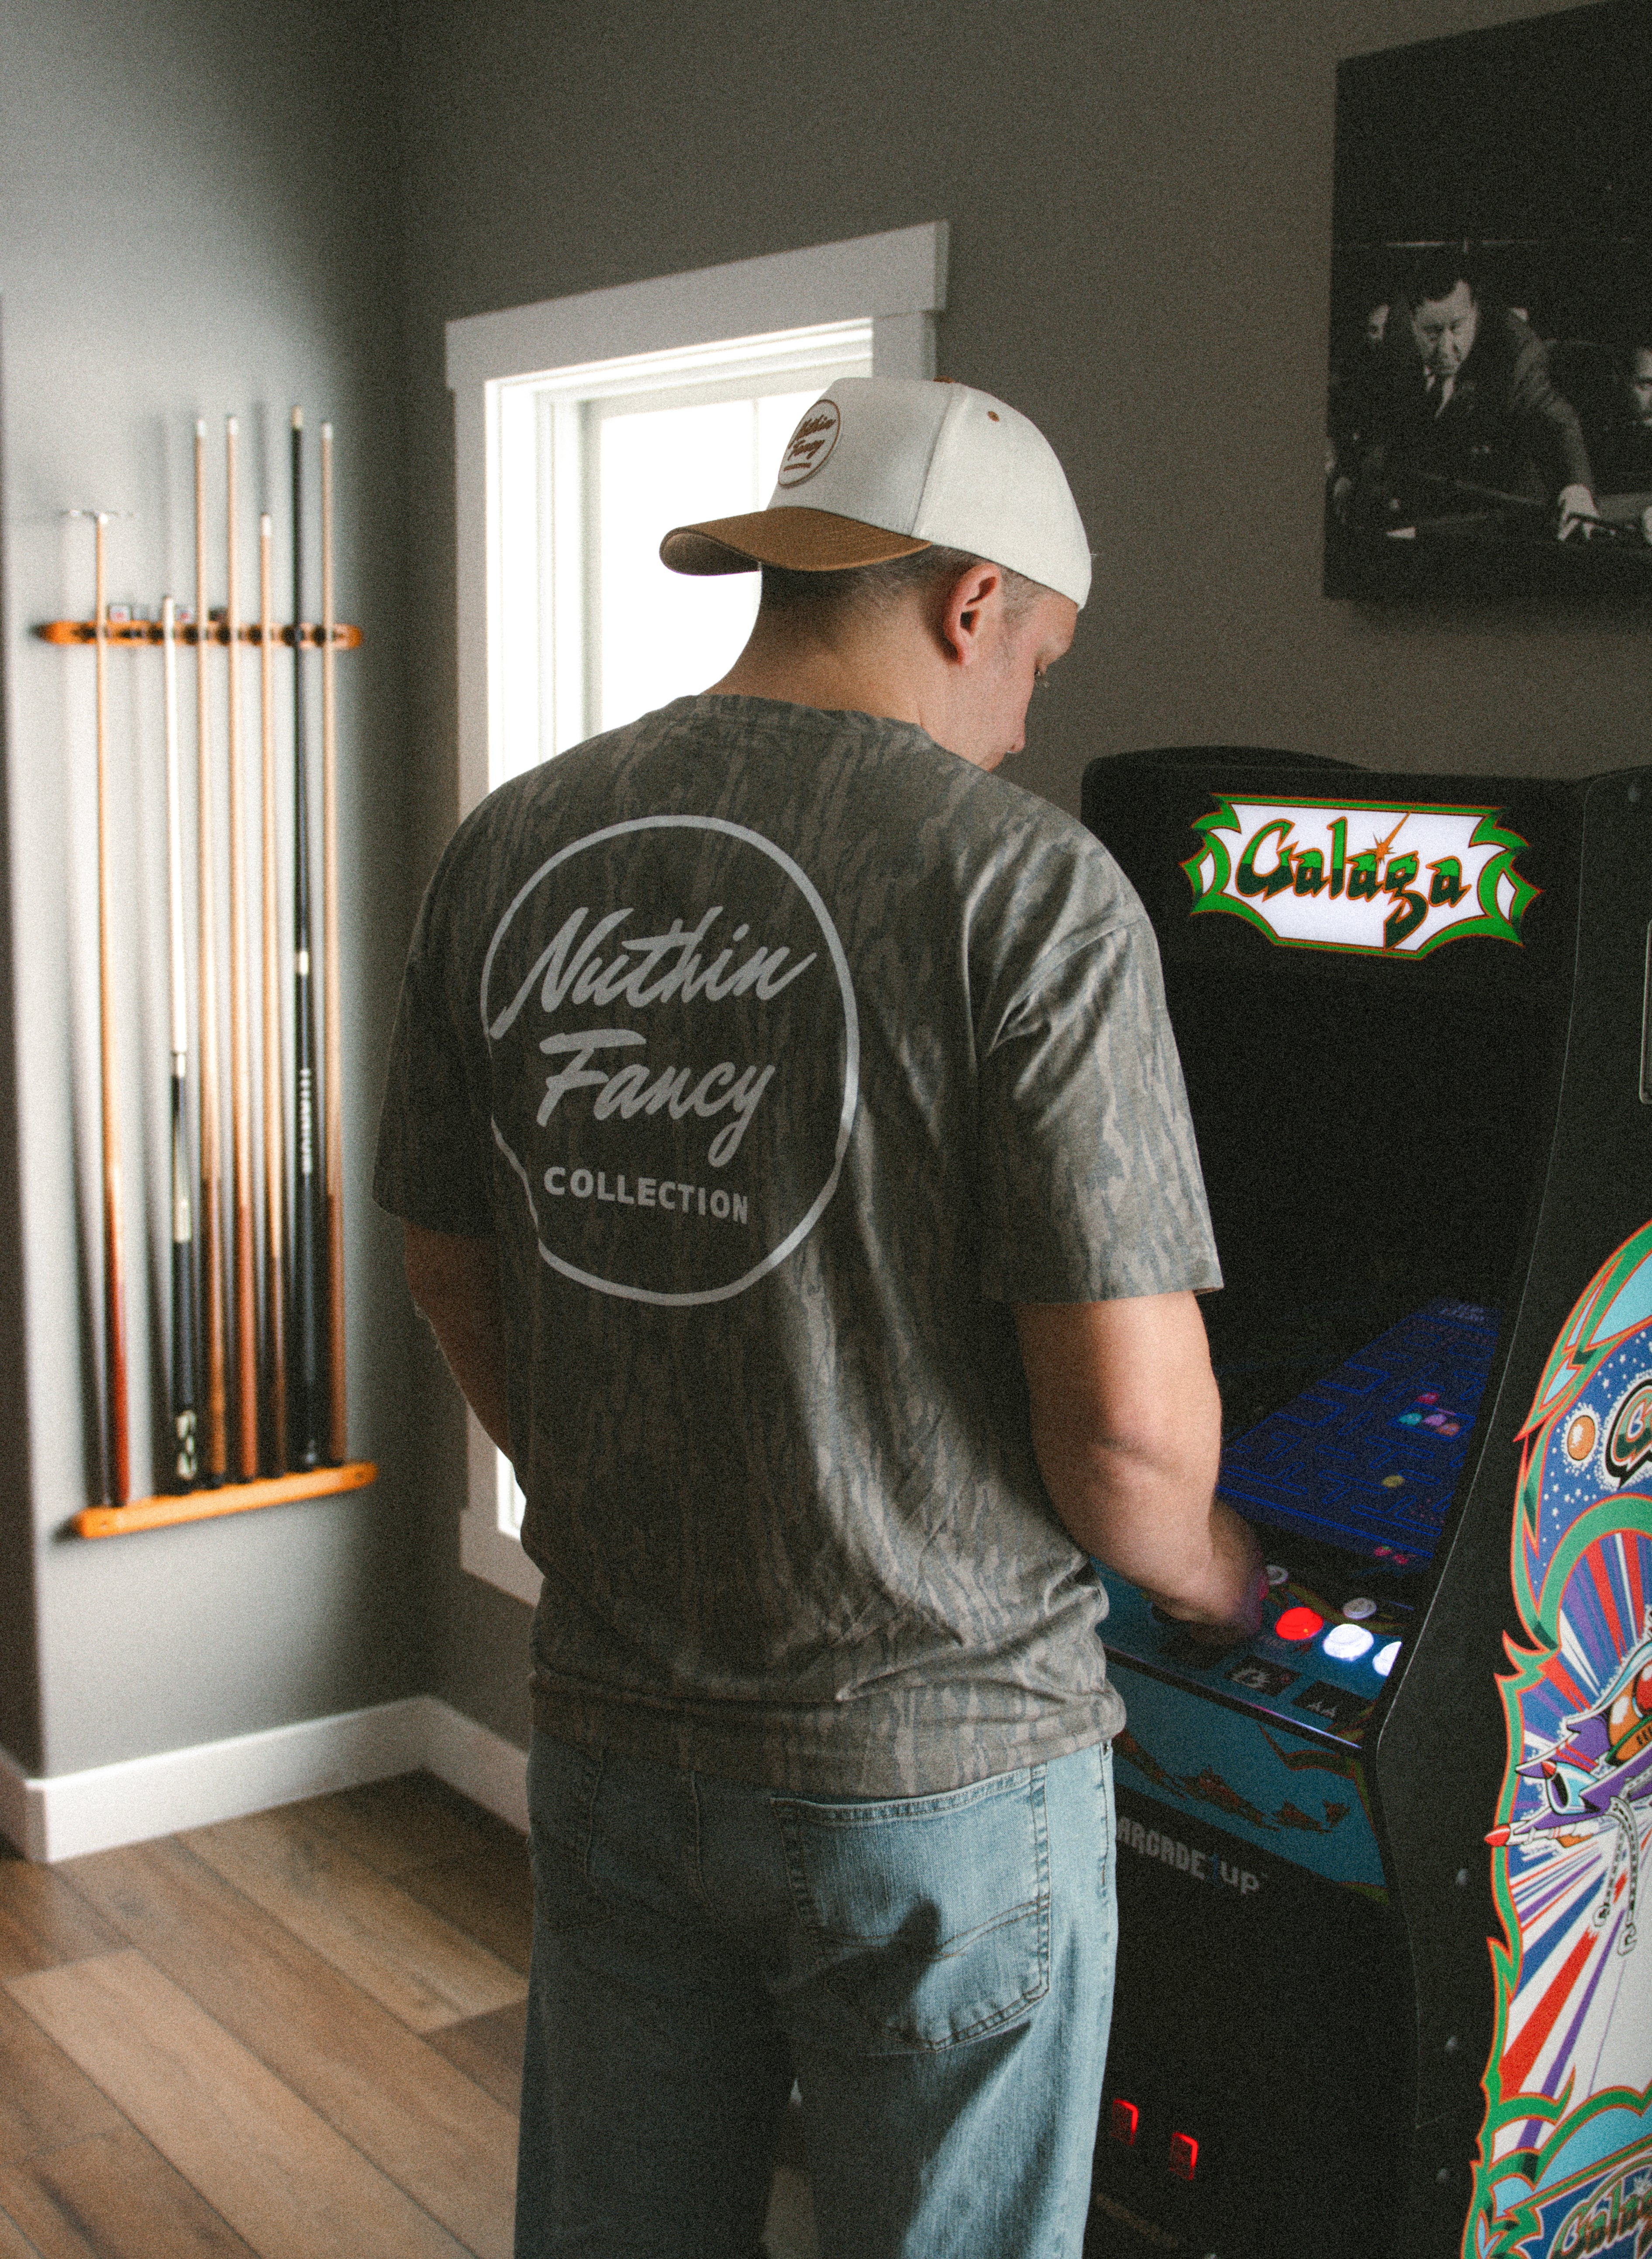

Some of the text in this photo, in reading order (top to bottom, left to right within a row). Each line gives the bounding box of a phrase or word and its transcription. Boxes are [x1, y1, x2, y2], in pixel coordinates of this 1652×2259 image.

[1235, 815, 1472, 950] Galaga
[489, 905, 817, 1040] Nuthin
[536, 1029, 776, 1167] Fancy
[543, 1166, 748, 1225] COLLECTION
